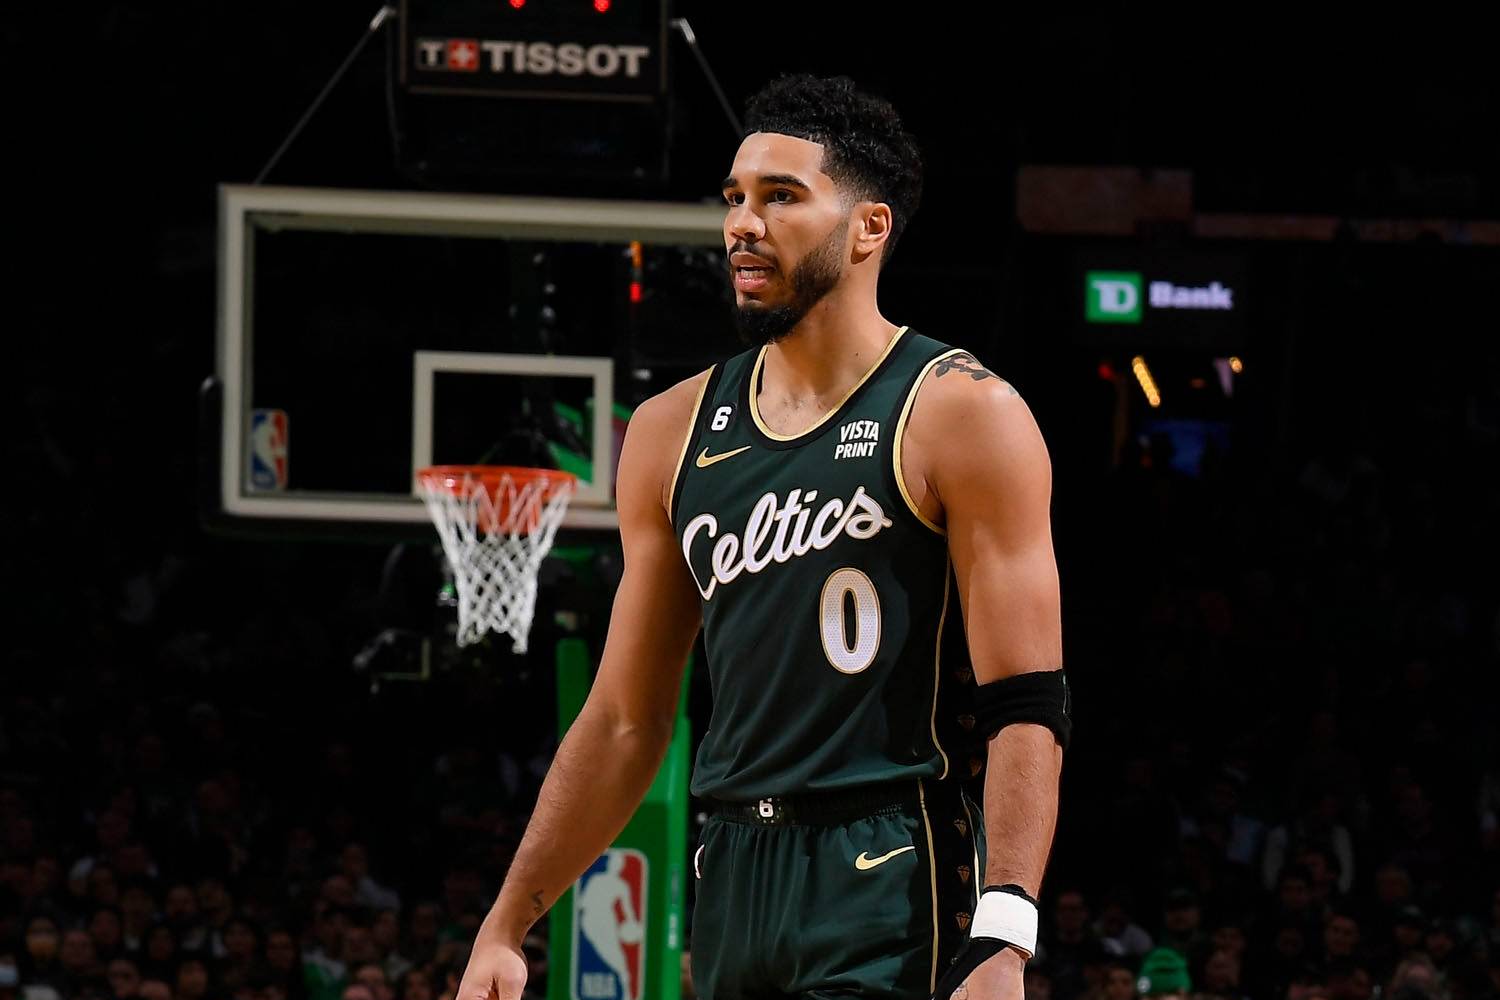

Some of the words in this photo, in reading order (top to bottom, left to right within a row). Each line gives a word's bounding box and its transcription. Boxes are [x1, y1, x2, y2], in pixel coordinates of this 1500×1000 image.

[482, 40, 649, 77] TISSOT
[1092, 280, 1137, 313] TD
[1149, 280, 1233, 310] Bank
[711, 406, 732, 431] 6
[840, 419, 879, 441] VISTA
[834, 441, 877, 460] PRINT
[682, 485, 893, 600] Celtics
[819, 567, 881, 674] 0
